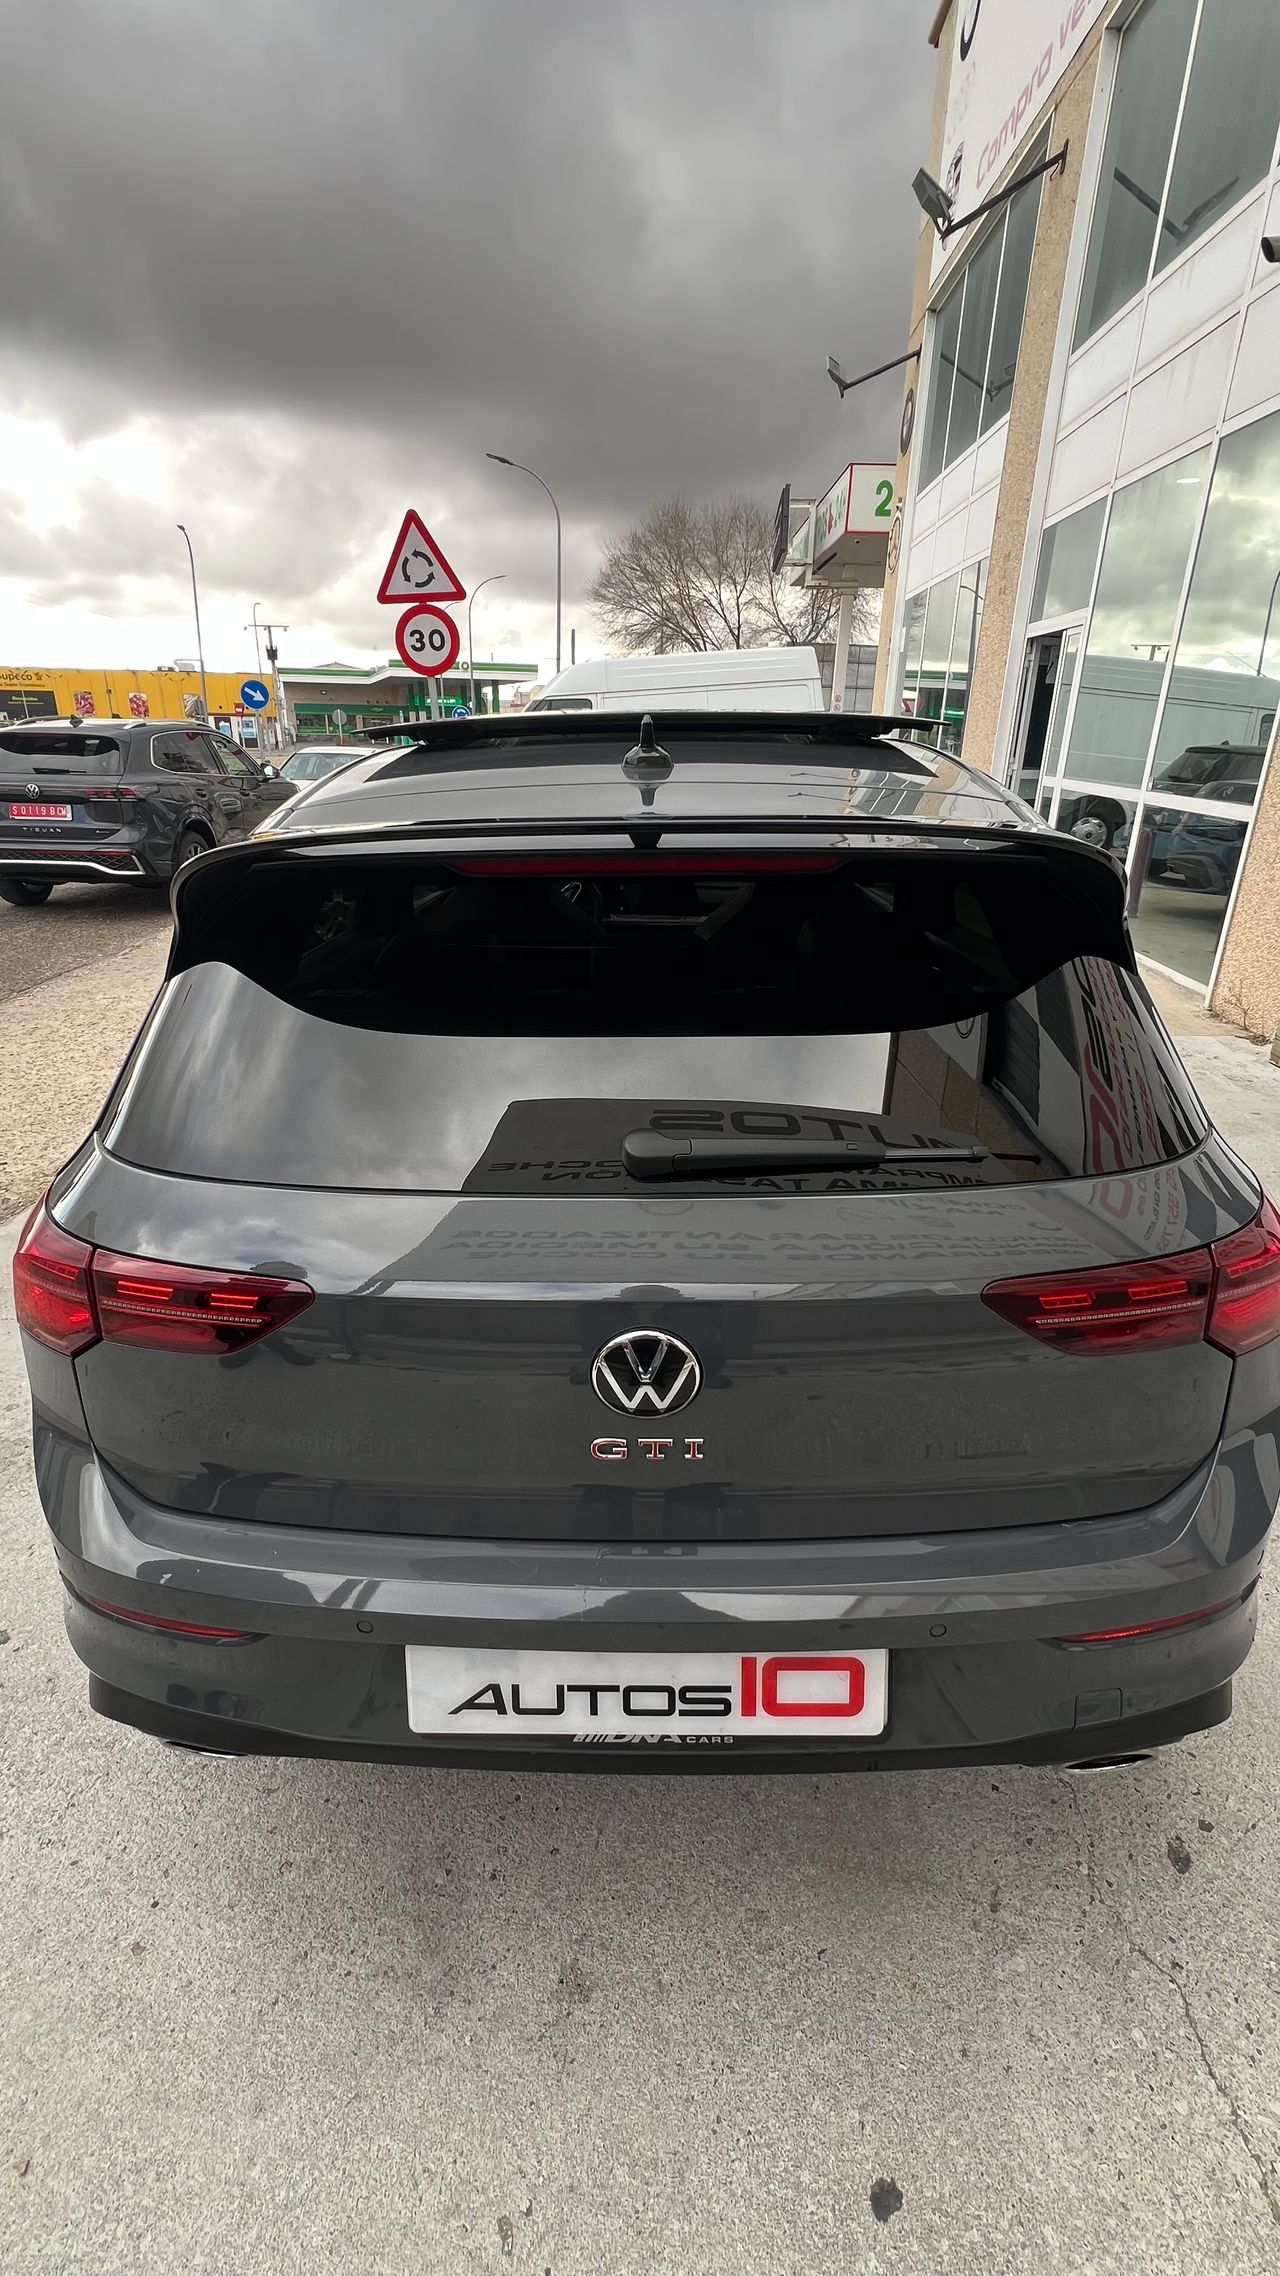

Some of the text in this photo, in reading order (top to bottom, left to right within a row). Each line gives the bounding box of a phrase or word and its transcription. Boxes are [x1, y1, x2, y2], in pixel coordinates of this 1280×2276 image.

[409, 629, 446, 652] 30
[591, 1437, 704, 1460] GTI
[686, 1735, 734, 1744] CARS
